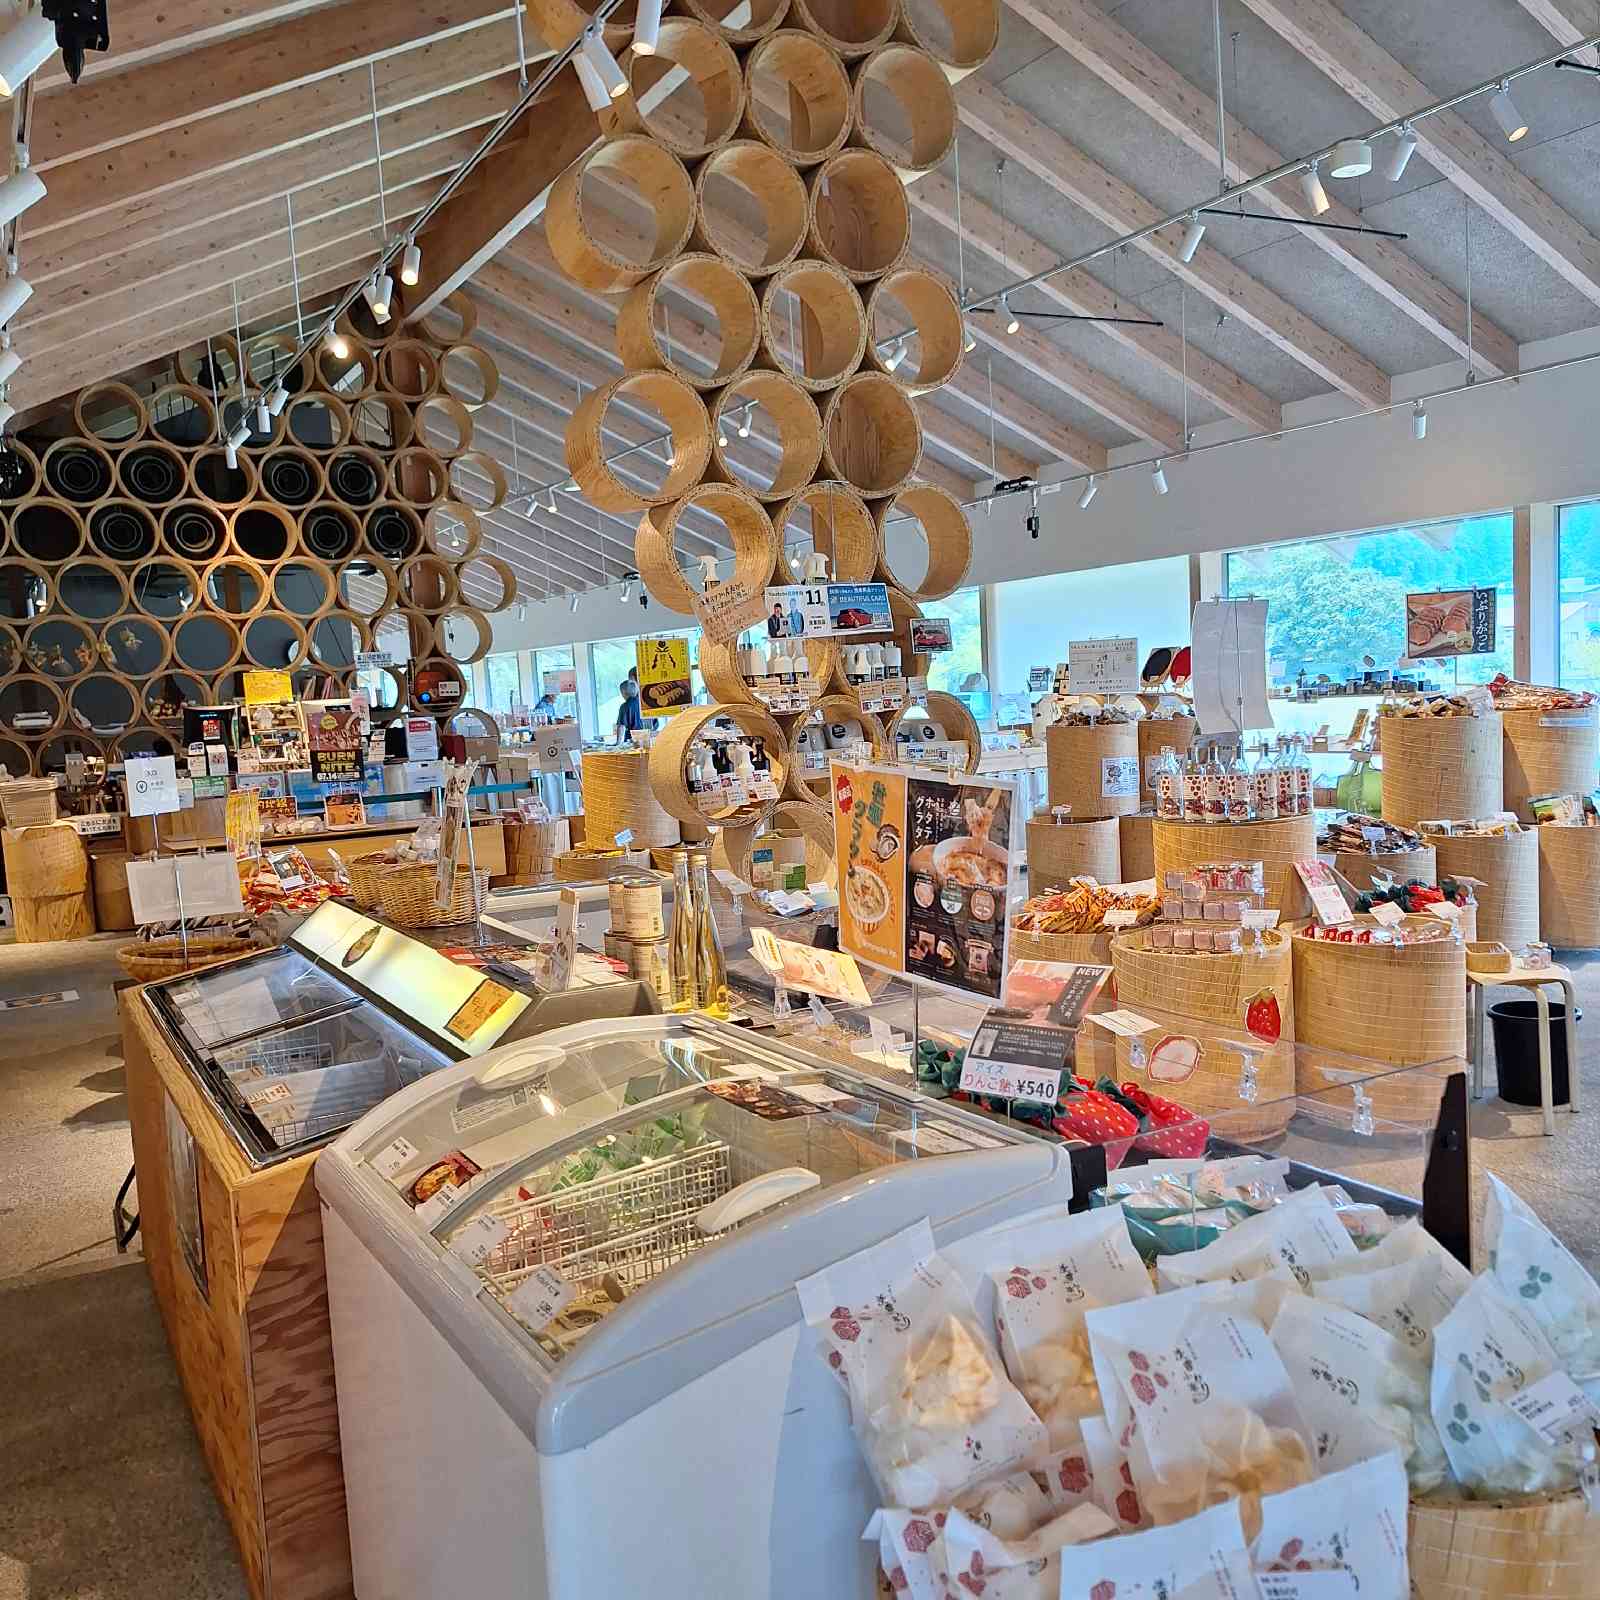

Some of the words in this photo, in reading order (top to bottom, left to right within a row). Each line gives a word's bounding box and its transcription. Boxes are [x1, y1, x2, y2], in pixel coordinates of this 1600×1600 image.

[1476, 591, 1489, 652] いぶりがっこ
[317, 751, 356, 761] BURN
[320, 762, 355, 772] NITE
[925, 796, 934, 839] ホタテ
[1076, 967, 1103, 977] NEW
[975, 1062, 1006, 1076] アイス
[1016, 1078, 1056, 1099] ¥540
